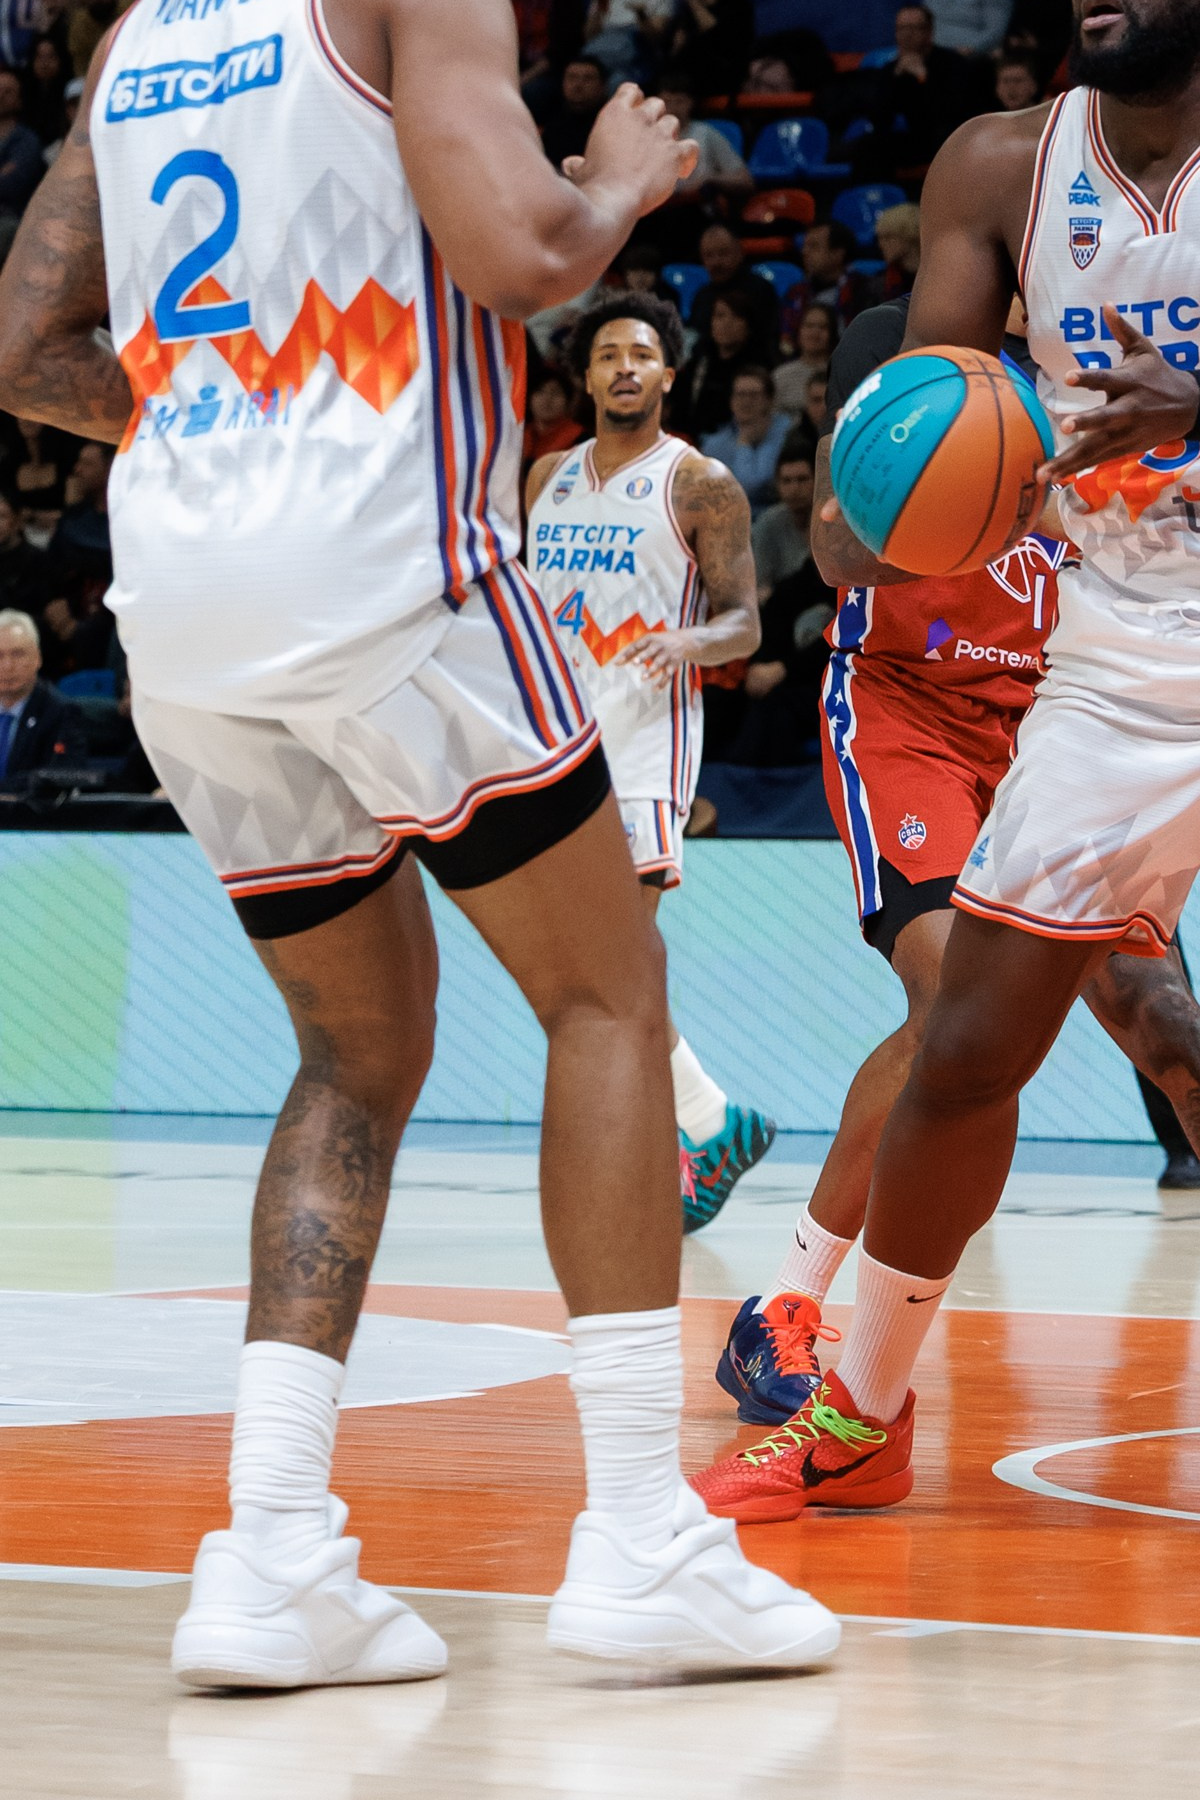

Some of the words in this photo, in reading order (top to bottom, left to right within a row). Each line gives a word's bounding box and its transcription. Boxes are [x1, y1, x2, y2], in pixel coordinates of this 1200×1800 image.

[1068, 192, 1101, 207] PEAK
[150, 149, 253, 342] 2
[536, 523, 645, 546] BETCITY
[536, 547, 637, 577] PARMA
[556, 589, 586, 637] 4
